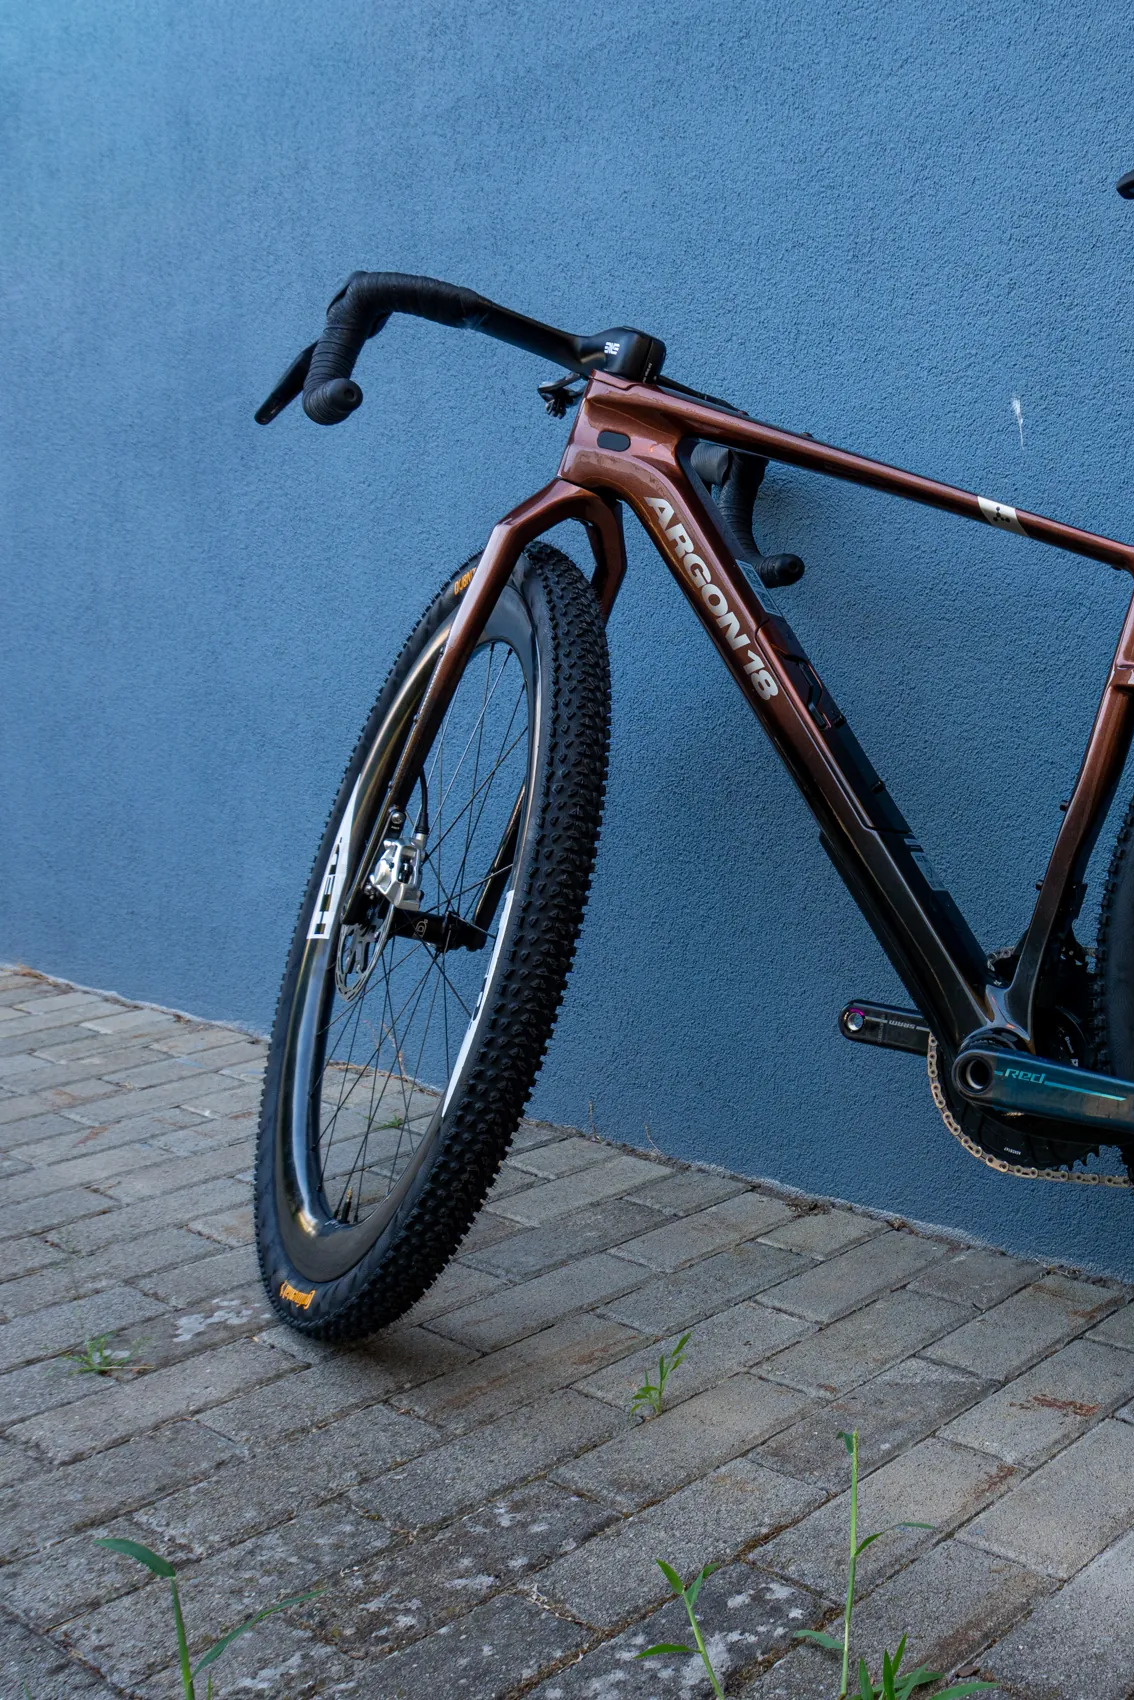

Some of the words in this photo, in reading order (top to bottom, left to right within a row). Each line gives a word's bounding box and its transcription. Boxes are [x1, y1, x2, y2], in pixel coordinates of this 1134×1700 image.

[643, 496, 751, 650] ARGON
[743, 650, 779, 700] 18
[889, 1020, 916, 1030] SRAM
